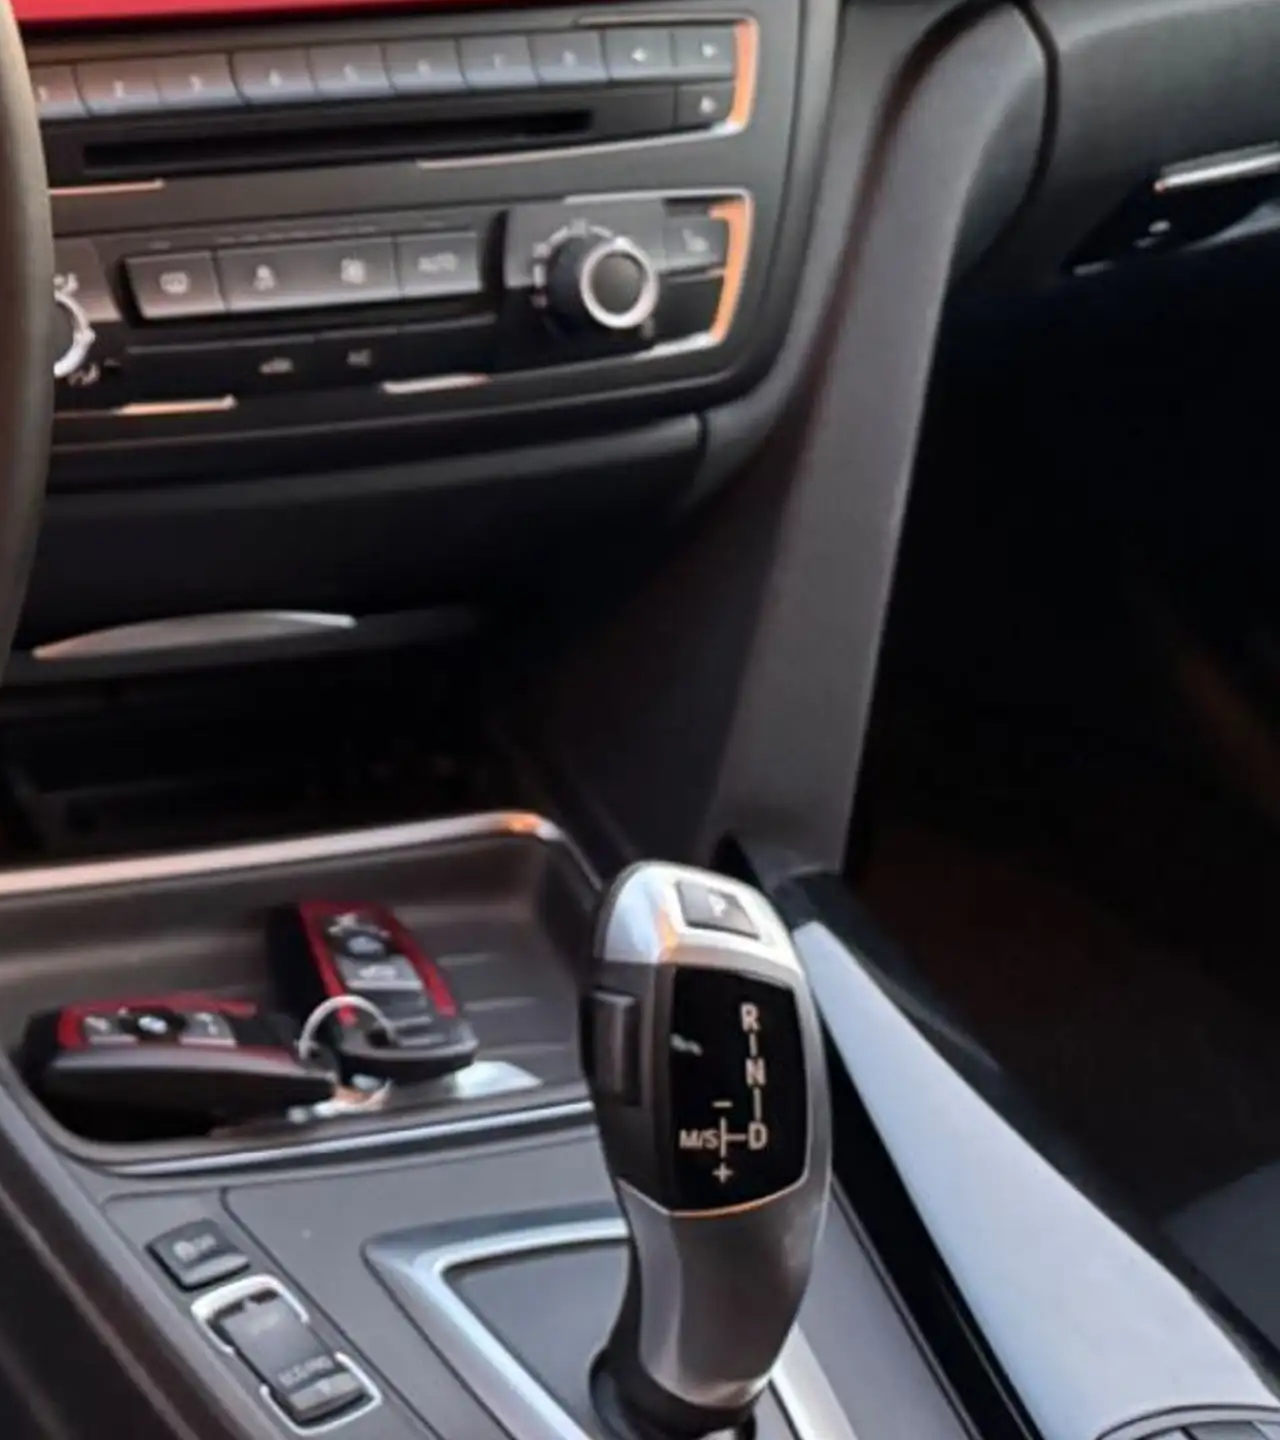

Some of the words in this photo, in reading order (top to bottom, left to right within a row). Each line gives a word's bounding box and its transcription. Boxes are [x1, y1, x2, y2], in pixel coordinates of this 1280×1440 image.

[740, 1000, 761, 1033] R
[745, 1057, 767, 1087] N
[679, 1127, 719, 1150] M/S
[747, 1122, 769, 1151] D
